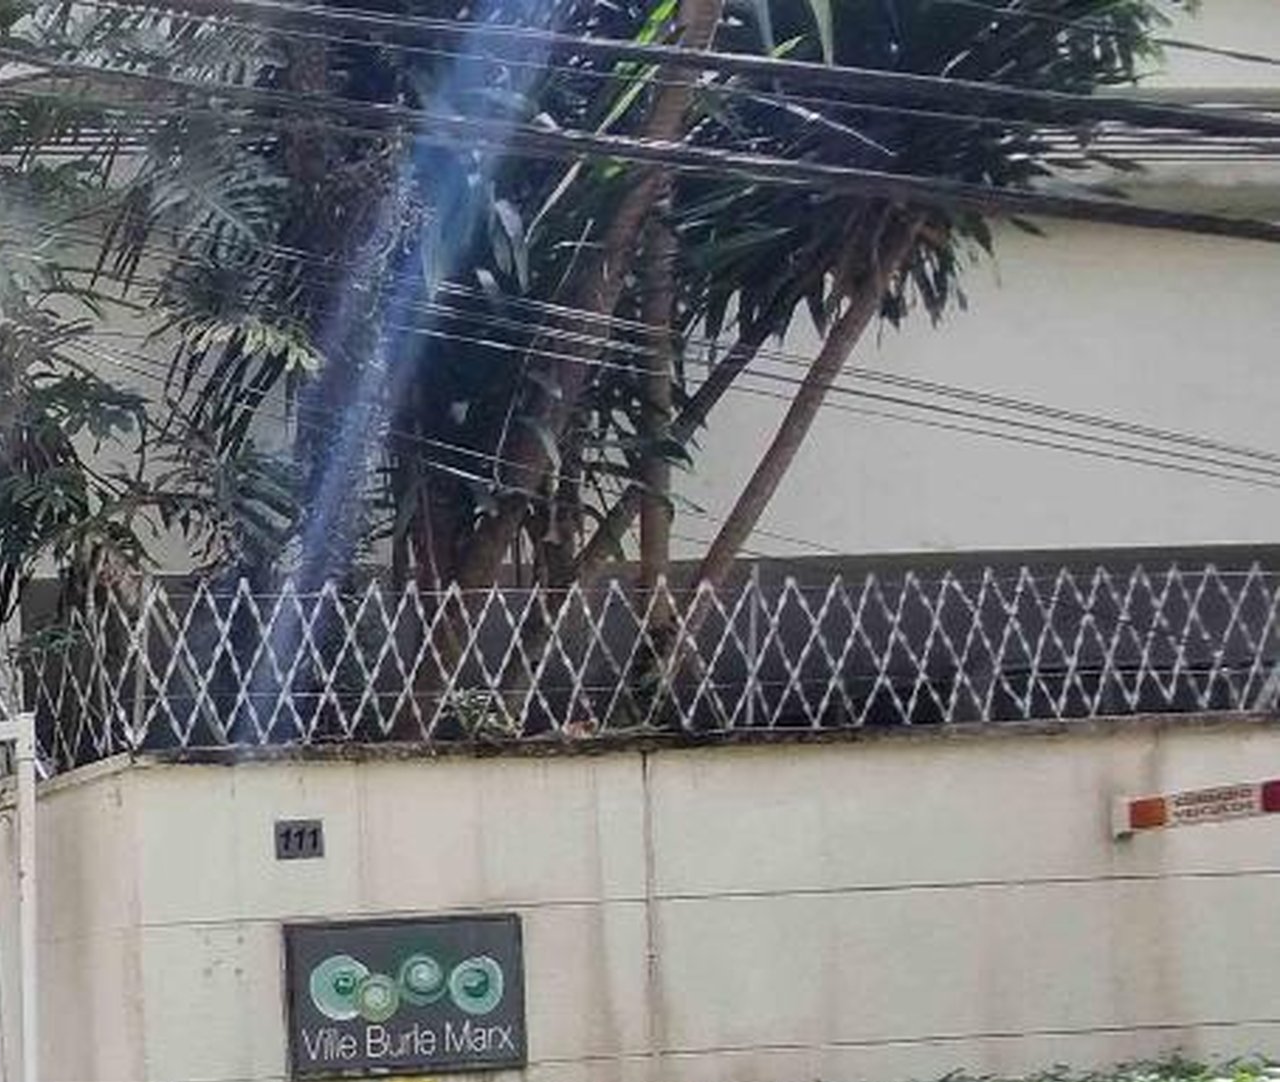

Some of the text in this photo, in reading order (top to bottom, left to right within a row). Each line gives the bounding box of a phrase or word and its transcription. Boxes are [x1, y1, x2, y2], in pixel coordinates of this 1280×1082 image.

[279, 827, 318, 851] 111
[301, 1019, 515, 1060] Ville Burle Marx
